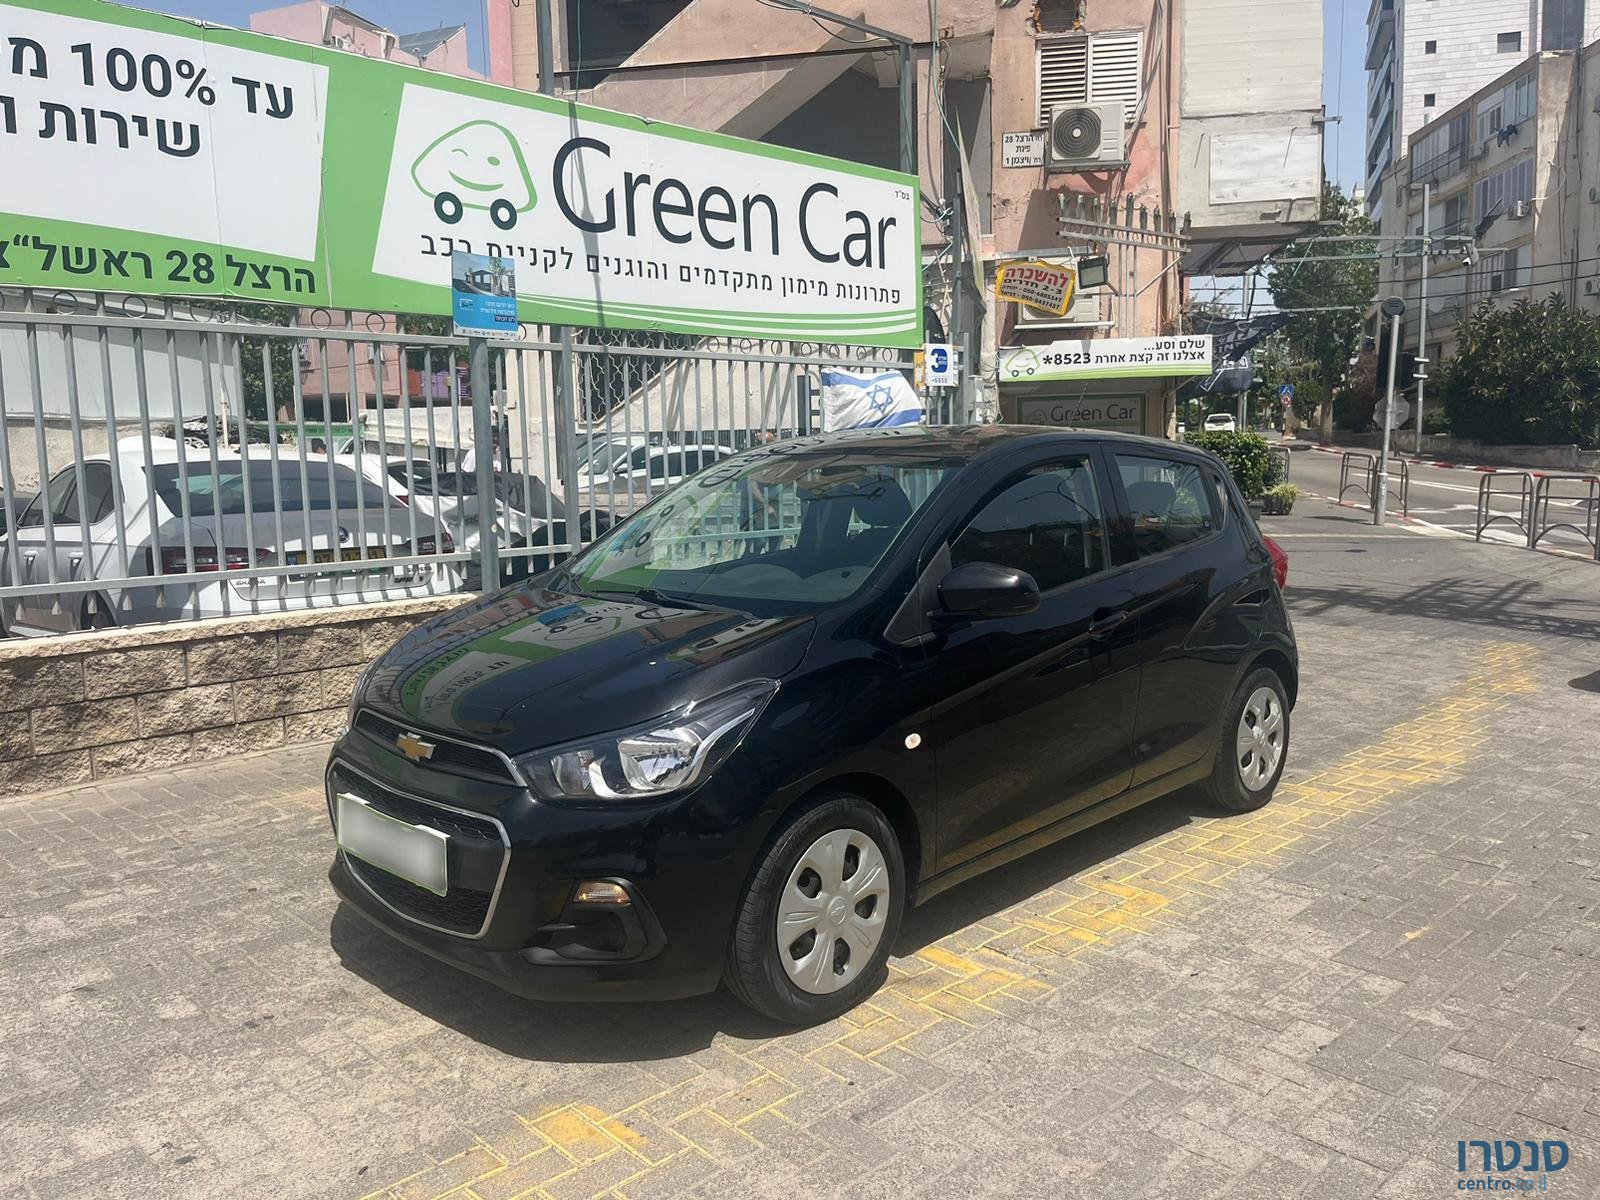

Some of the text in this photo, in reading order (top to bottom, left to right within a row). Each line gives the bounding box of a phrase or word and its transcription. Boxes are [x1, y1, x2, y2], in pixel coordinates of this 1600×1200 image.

[70, 42, 216, 107] 100%
[231, 76, 294, 119] עד
[38, 101, 201, 158] שירות
[551, 136, 897, 270] Green Car
[165, 249, 215, 285] 28
[225, 253, 316, 294] הרצל
[586, 254, 668, 280] והוגנים
[679, 265, 772, 293] מתקדמים
[781, 276, 828, 298] מימון
[1003, 279, 1039, 288] חדרים
[1005, 268, 1069, 288] להשכרה
[836, 283, 900, 304] פתרונות
[1179, 339, 1205, 350] שלם
[1095, 354, 1126, 365] אחרת
[1128, 354, 1153, 364] קצת
[1156, 353, 1170, 361] זה
[1172, 350, 1205, 361] אצלנו
[1050, 403, 1137, 422] Green Car
